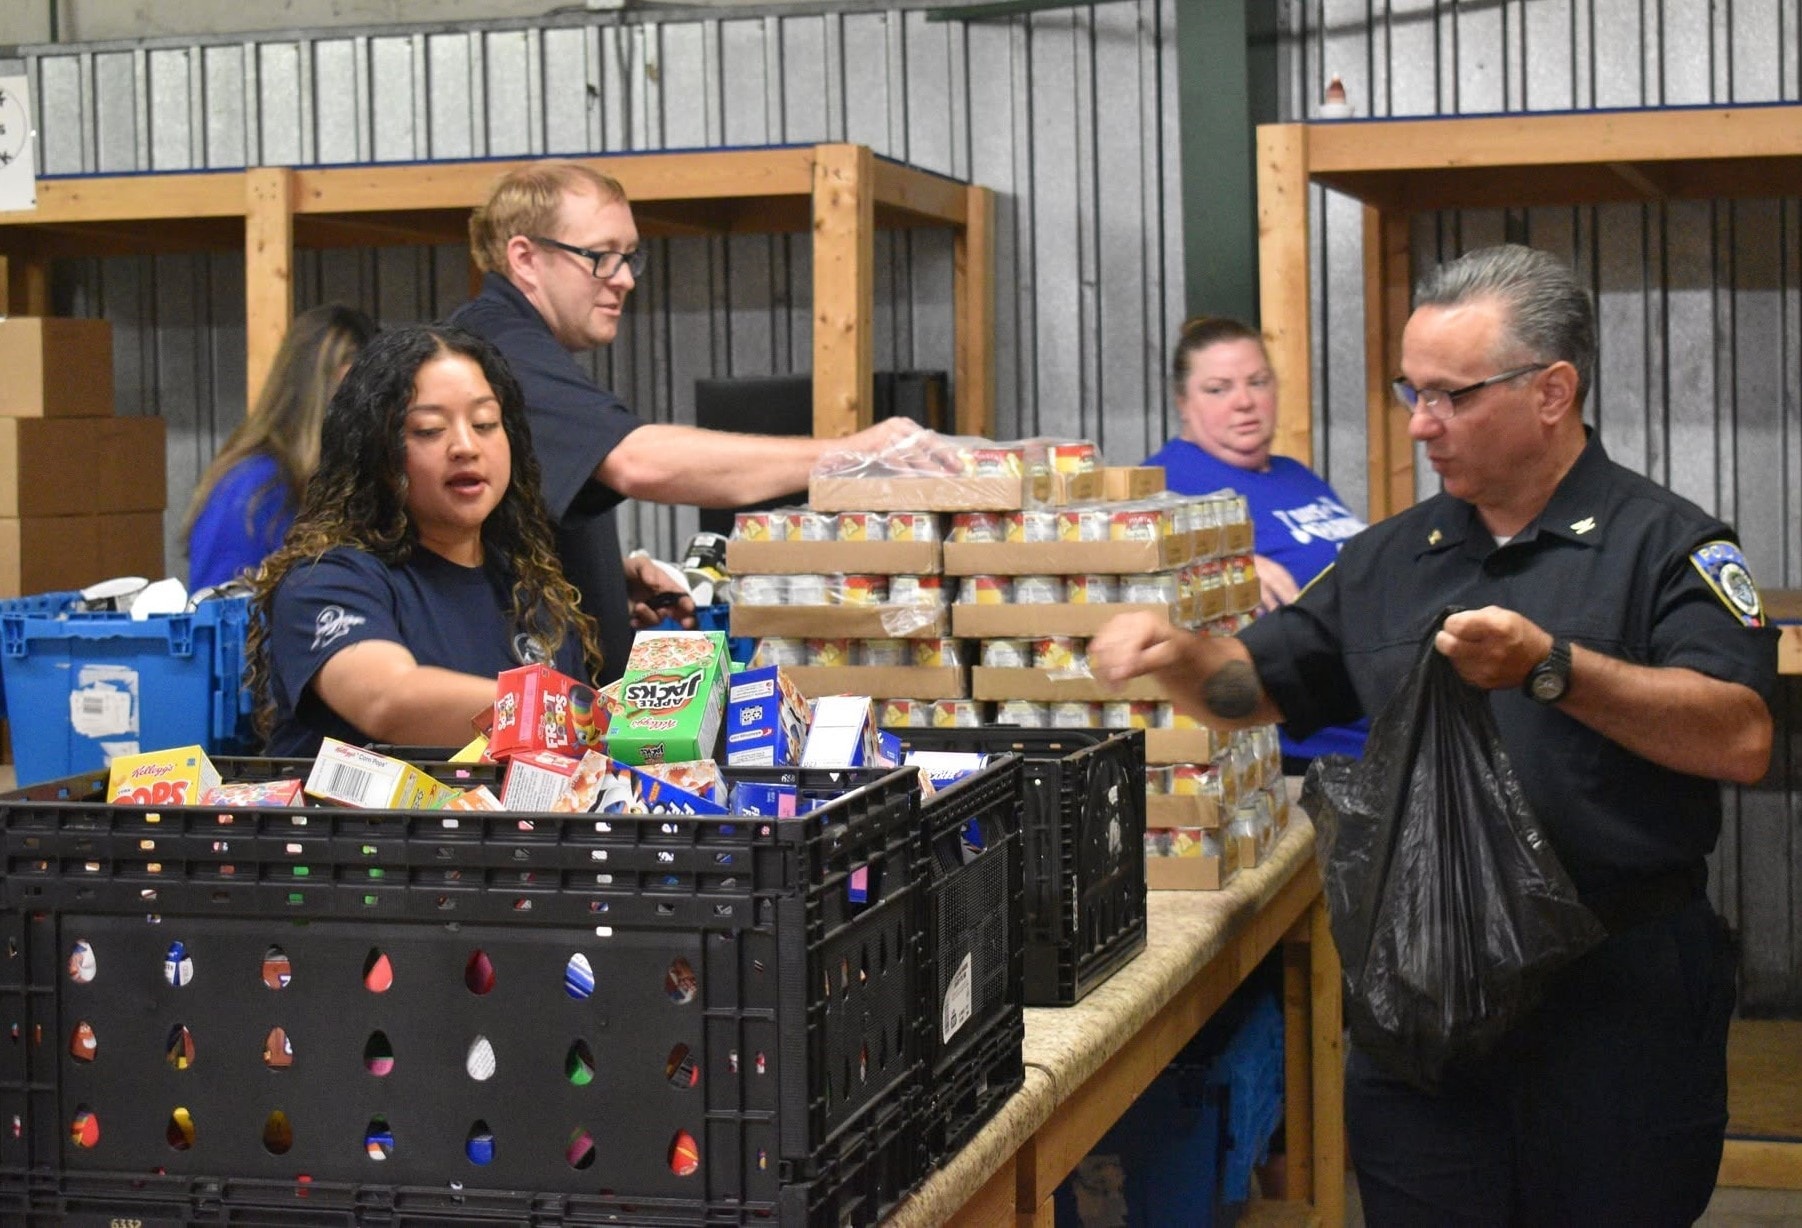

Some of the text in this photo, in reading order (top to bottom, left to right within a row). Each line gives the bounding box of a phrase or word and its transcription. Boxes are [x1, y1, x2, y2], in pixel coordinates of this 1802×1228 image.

[627, 672, 703, 701] JACKS
[639, 698, 684, 707] APPLE
[543, 690, 559, 748] FROOT
[555, 694, 569, 746] LOOPS
[630, 718, 678, 730] Kellogg's
[358, 754, 373, 764] Corn
[372, 757, 386, 769] Pops
[131, 763, 175, 778] Kellogg's
